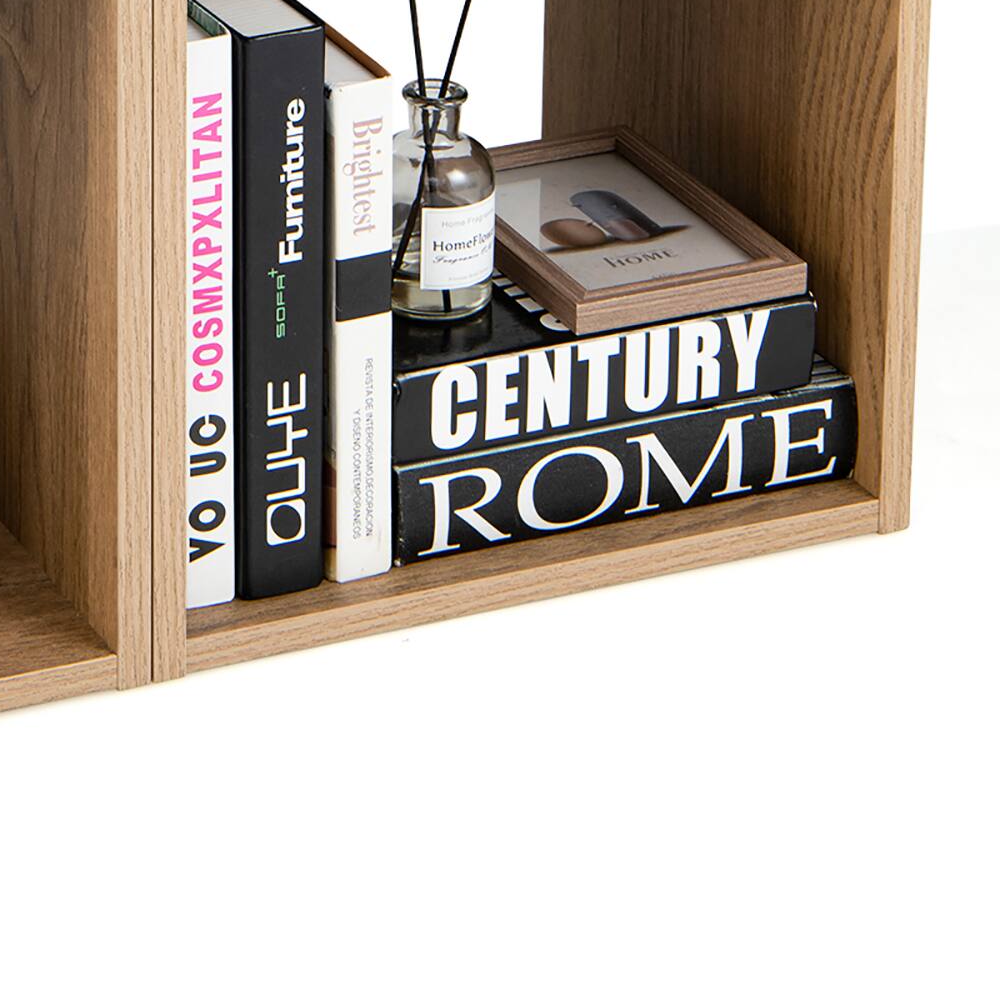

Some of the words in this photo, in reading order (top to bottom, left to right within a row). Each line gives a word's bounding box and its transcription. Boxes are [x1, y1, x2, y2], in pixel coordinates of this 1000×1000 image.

[191, 92, 224, 393] COSMXPXLITAN
[278, 97, 306, 264] Furniture
[342, 116, 384, 237] Brightest
[364, 357, 374, 396] REVISTA
[364, 398, 374, 411] DE
[431, 309, 771, 451] CENTURY
[418, 399, 838, 557] ROME
